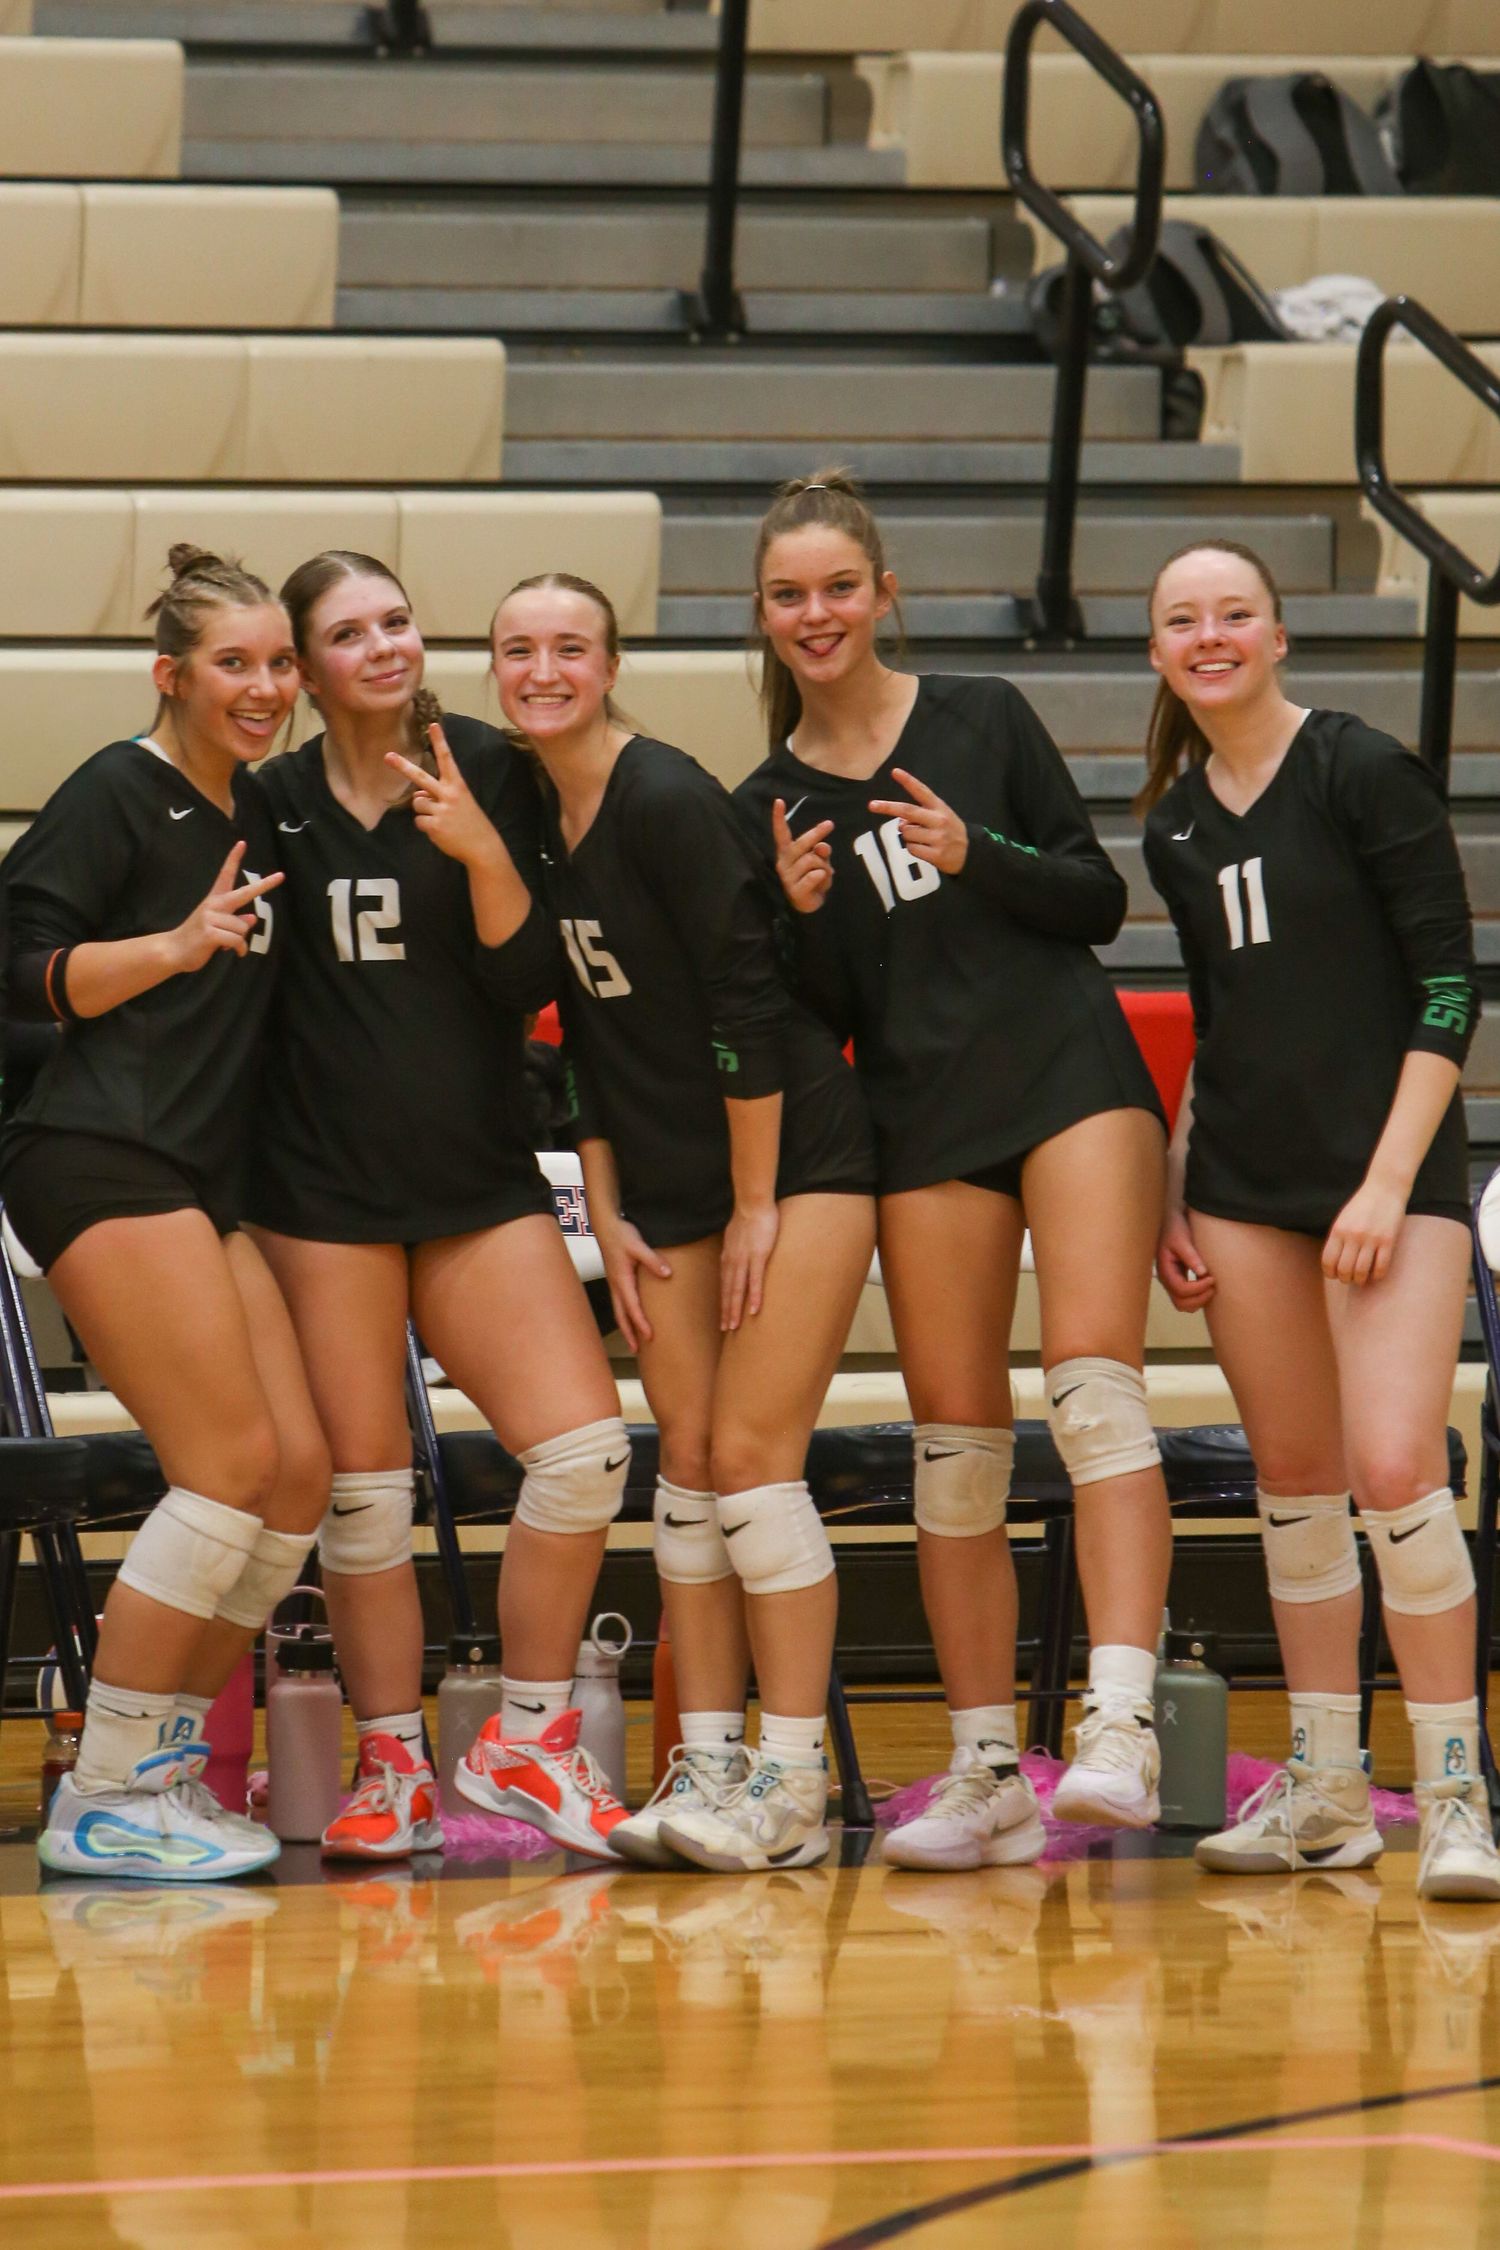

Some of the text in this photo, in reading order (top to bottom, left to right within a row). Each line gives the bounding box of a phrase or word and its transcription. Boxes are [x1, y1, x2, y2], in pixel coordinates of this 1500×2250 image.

[854, 816, 941, 913] 16
[1217, 856, 1272, 951] 11
[327, 878, 406, 962] 12
[559, 919, 632, 999] 15
